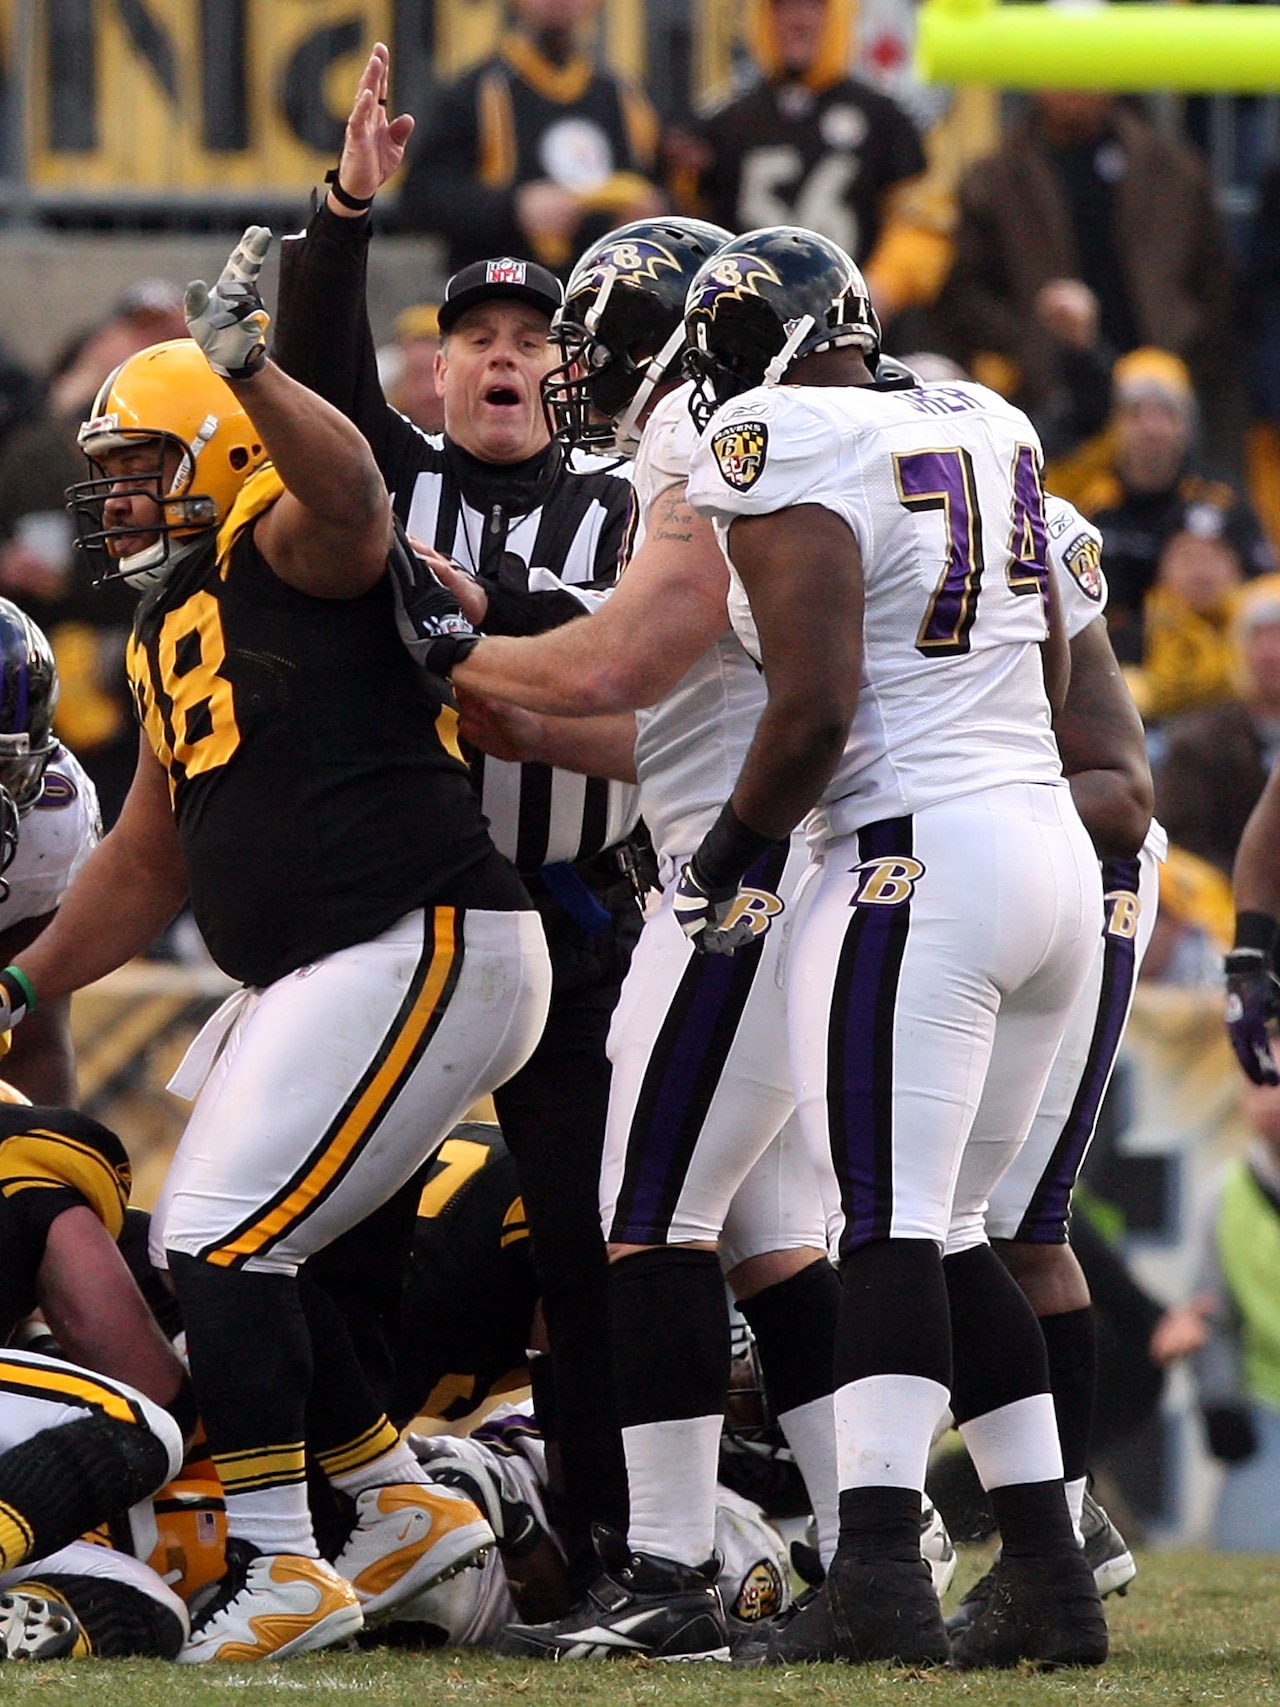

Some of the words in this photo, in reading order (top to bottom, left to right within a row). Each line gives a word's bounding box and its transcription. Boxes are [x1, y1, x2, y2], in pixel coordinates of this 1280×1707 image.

[491, 269, 522, 282] NFL
[715, 424, 762, 440] RAVENS
[891, 441, 1049, 658] 74
[847, 856, 927, 907] B
[717, 886, 787, 938] B
[1104, 889, 1141, 939] B
